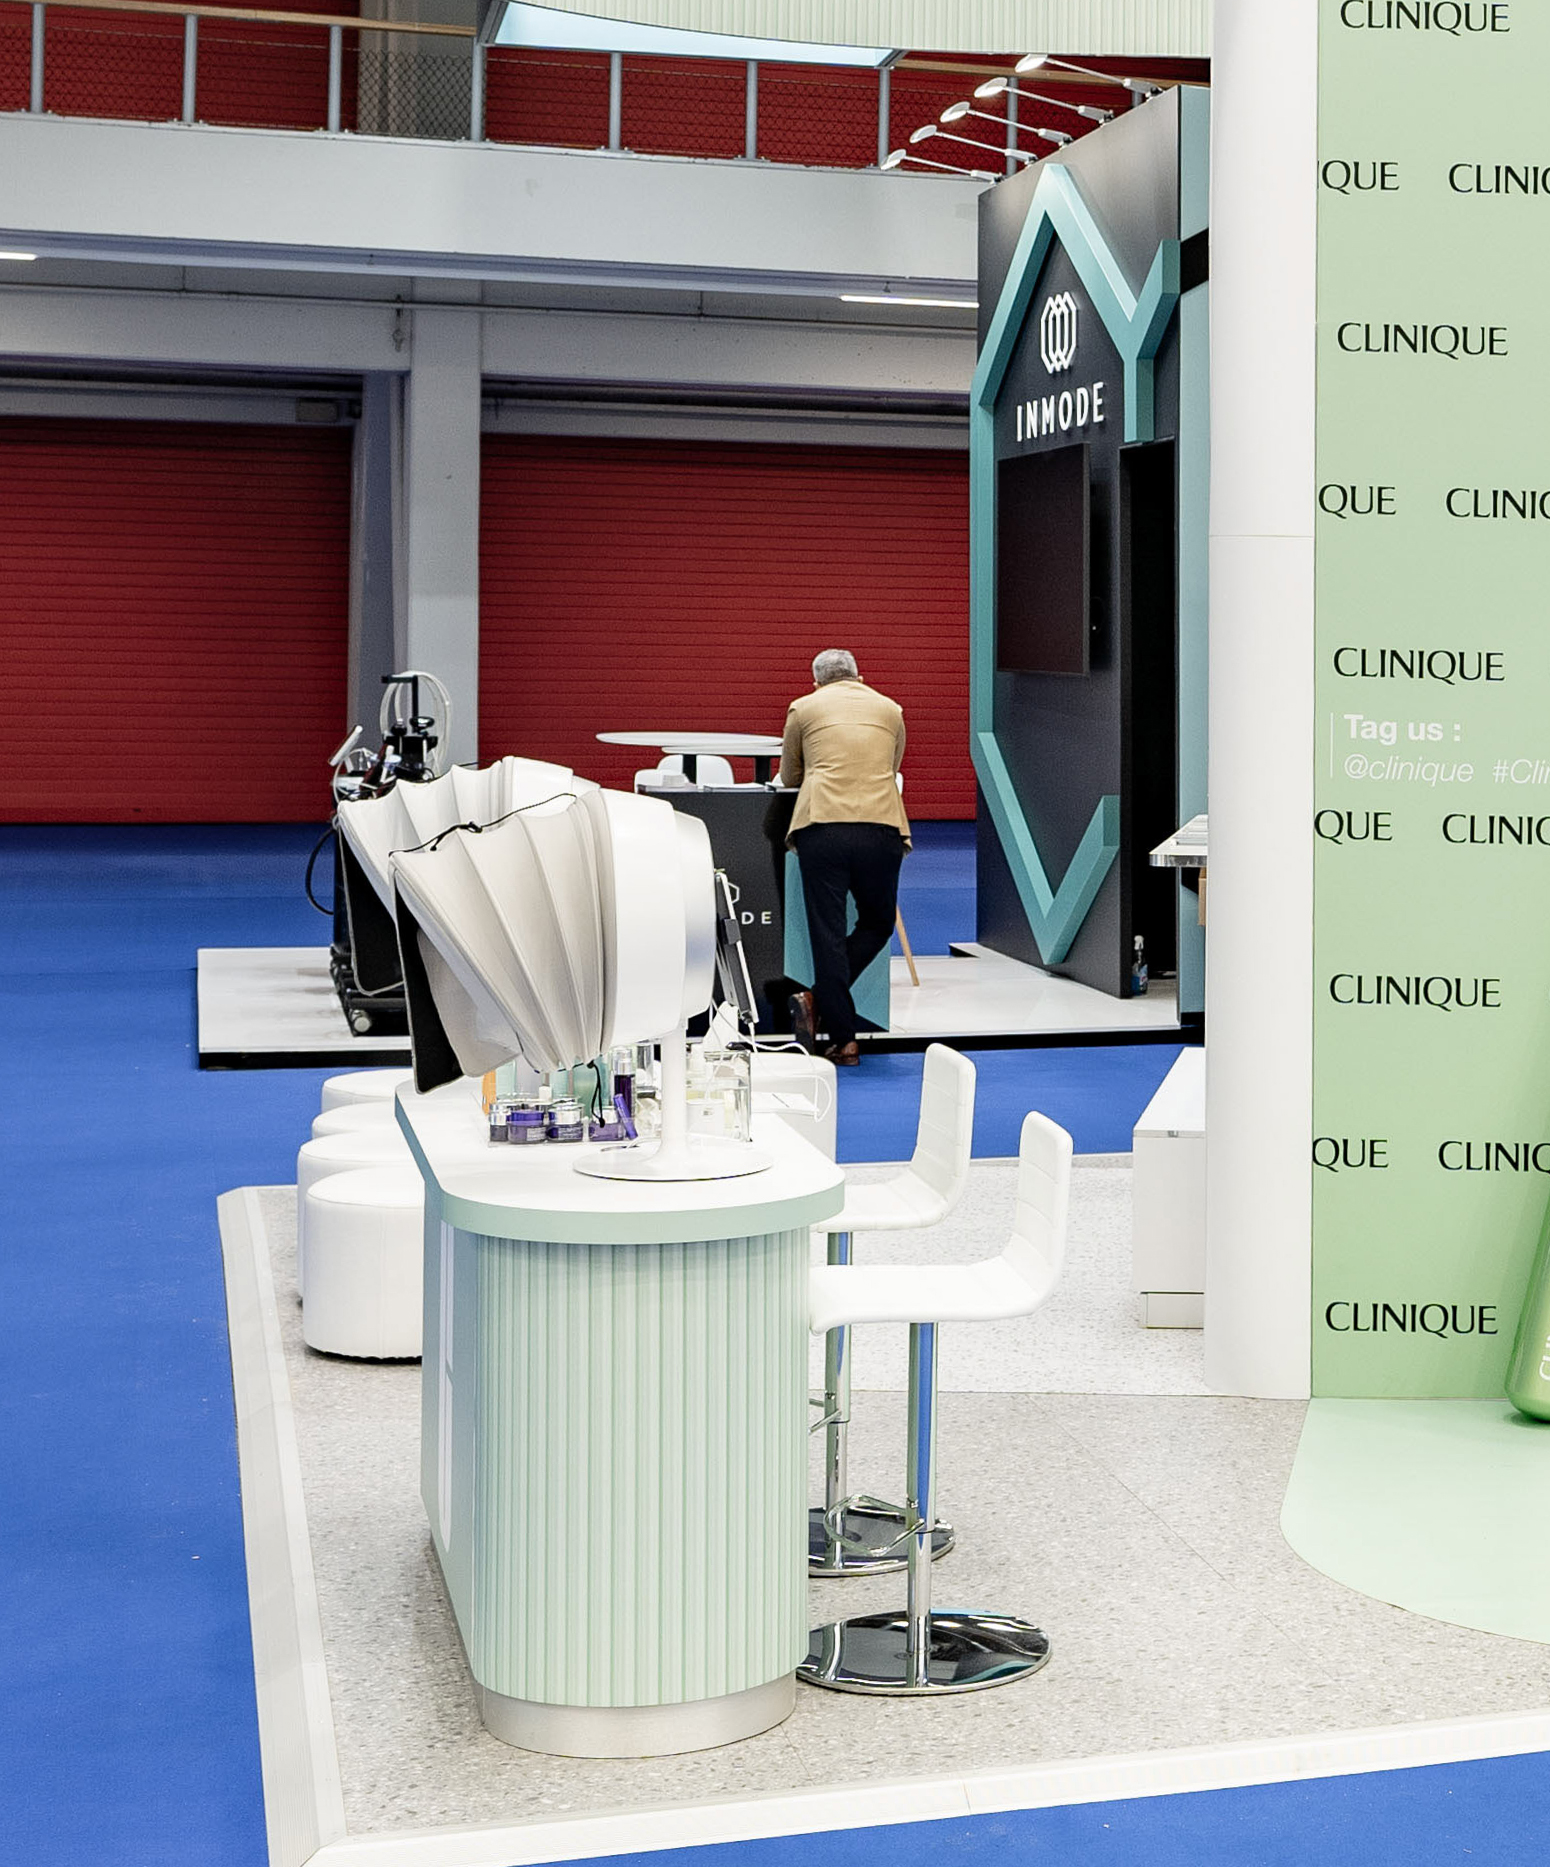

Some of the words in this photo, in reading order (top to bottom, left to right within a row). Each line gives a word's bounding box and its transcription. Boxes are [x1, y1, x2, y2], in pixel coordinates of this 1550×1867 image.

[1340, 0, 1510, 36] CLINIQUE
[1337, 322, 1508, 360] CLINIQUE
[1016, 382, 1105, 443] INMODE
[1333, 647, 1505, 686] CLINIQUE
[1344, 713, 1398, 747] Tag
[1407, 719, 1445, 742] us
[1344, 753, 1475, 786] @clinique
[1329, 973, 1501, 1012] CLINIQUE
[1325, 1301, 1498, 1339] CLINIQUE
